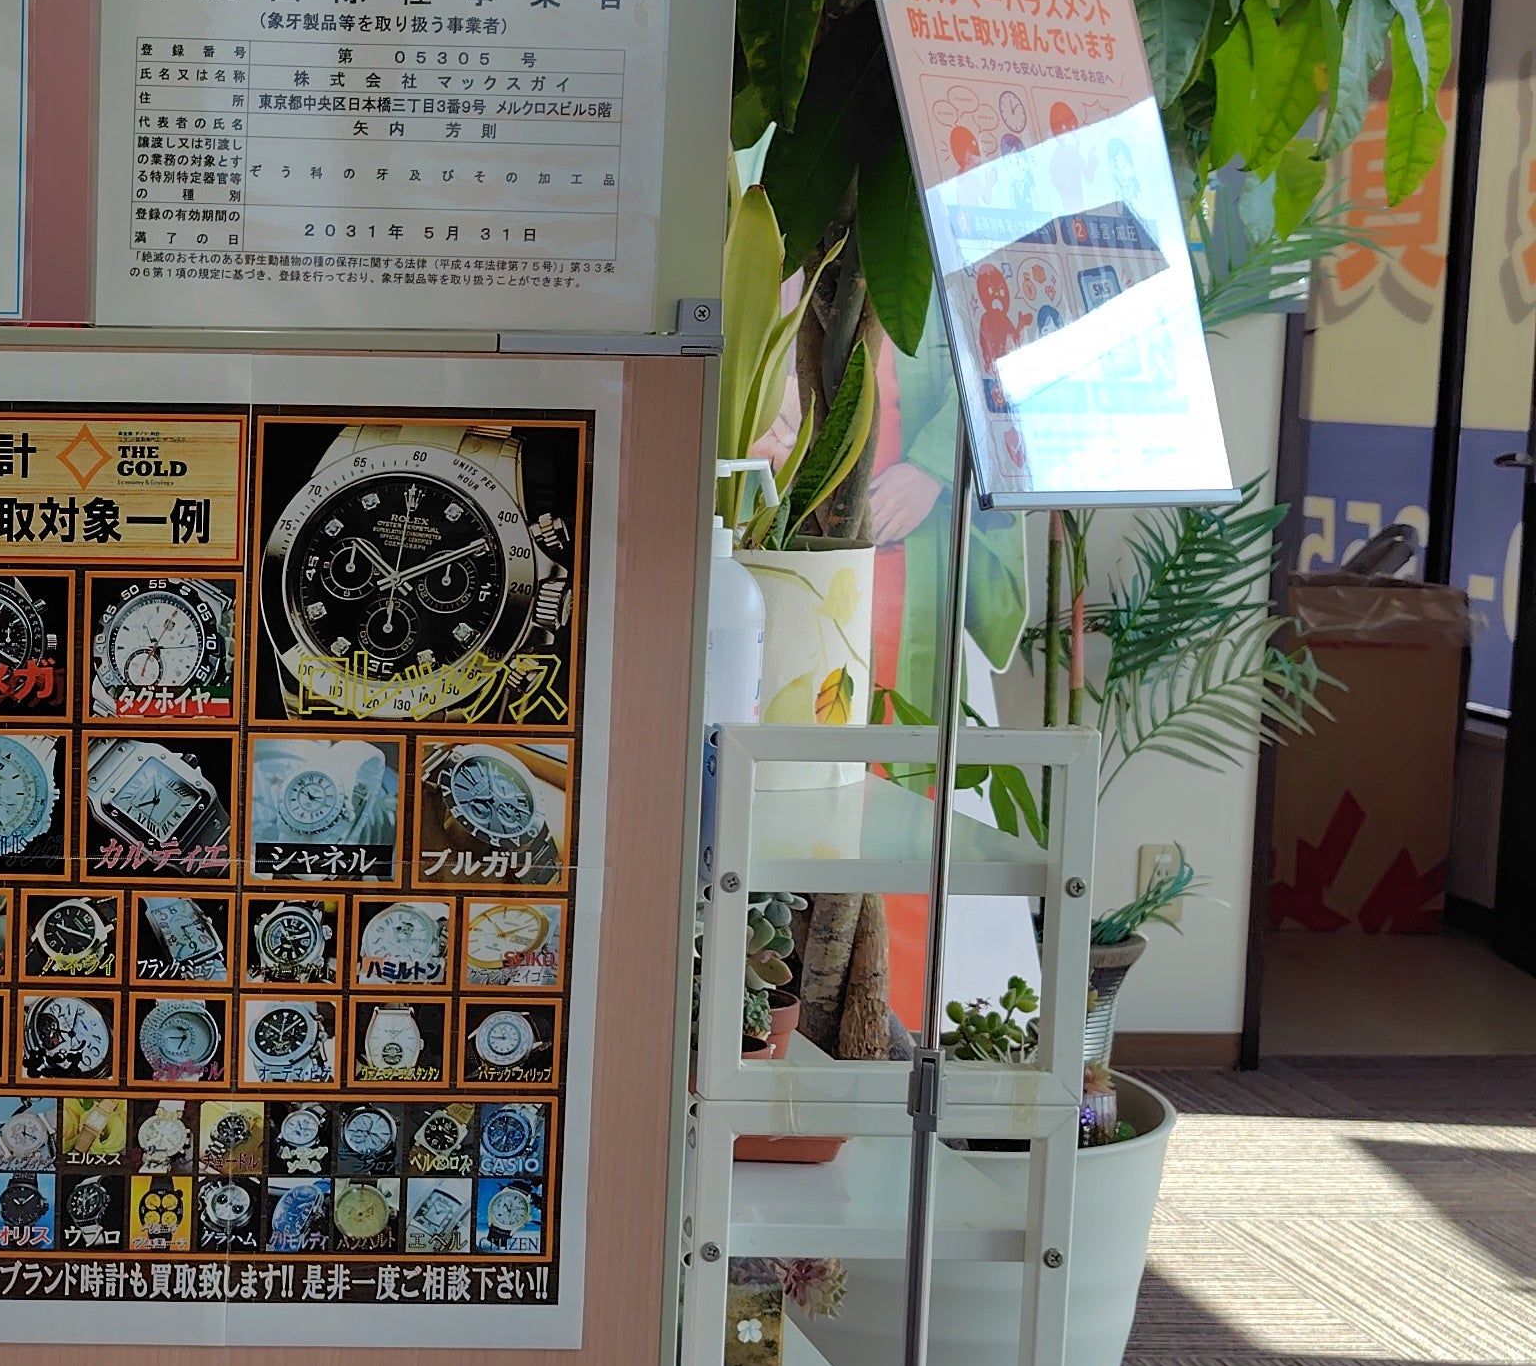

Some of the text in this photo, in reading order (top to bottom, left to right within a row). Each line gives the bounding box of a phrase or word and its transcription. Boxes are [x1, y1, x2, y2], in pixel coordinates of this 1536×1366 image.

[259, 12, 508, 35] (象牙製品等を取り扱う事業者)
[906, 8, 1117, 62] 防止に取り組んでいます
[141, 43, 247, 60] 登録番号
[140, 67, 246, 84] 氏名又は名称
[928, 51, 1115, 85] お客さまも、スタッフも安心して過ごせるお店へ
[258, 93, 613, 119] 東京都中央区日本橋三丁目3番9号 メルクロスビル5階
[138, 116, 243, 132] 代表者の氏名
[137, 136, 243, 152] 譲渡し又は引渡し
[136, 154, 243, 170] の業務の対象とす
[136, 170, 242, 187] る特別特定器官等
[135, 207, 241, 223] 登録の有効期間の
[118, 446, 159, 458] THE
[117, 460, 187, 477] GOLD
[391, 514, 430, 526] ROLEX
[118, 686, 231, 714] タグホイヤー
[94, 838, 230, 873] カルティエ
[271, 845, 378, 874] シャネル
[422, 849, 532, 878] ブルガリ
[504, 951, 556, 968] SEIKO
[367, 961, 444, 980] ハミルトン
[66, 1152, 121, 1166] エルメス
[480, 1158, 539, 1172] CASIO
[64, 1226, 120, 1247] ウブロ
[479, 1237, 539, 1251] CITIZEN
